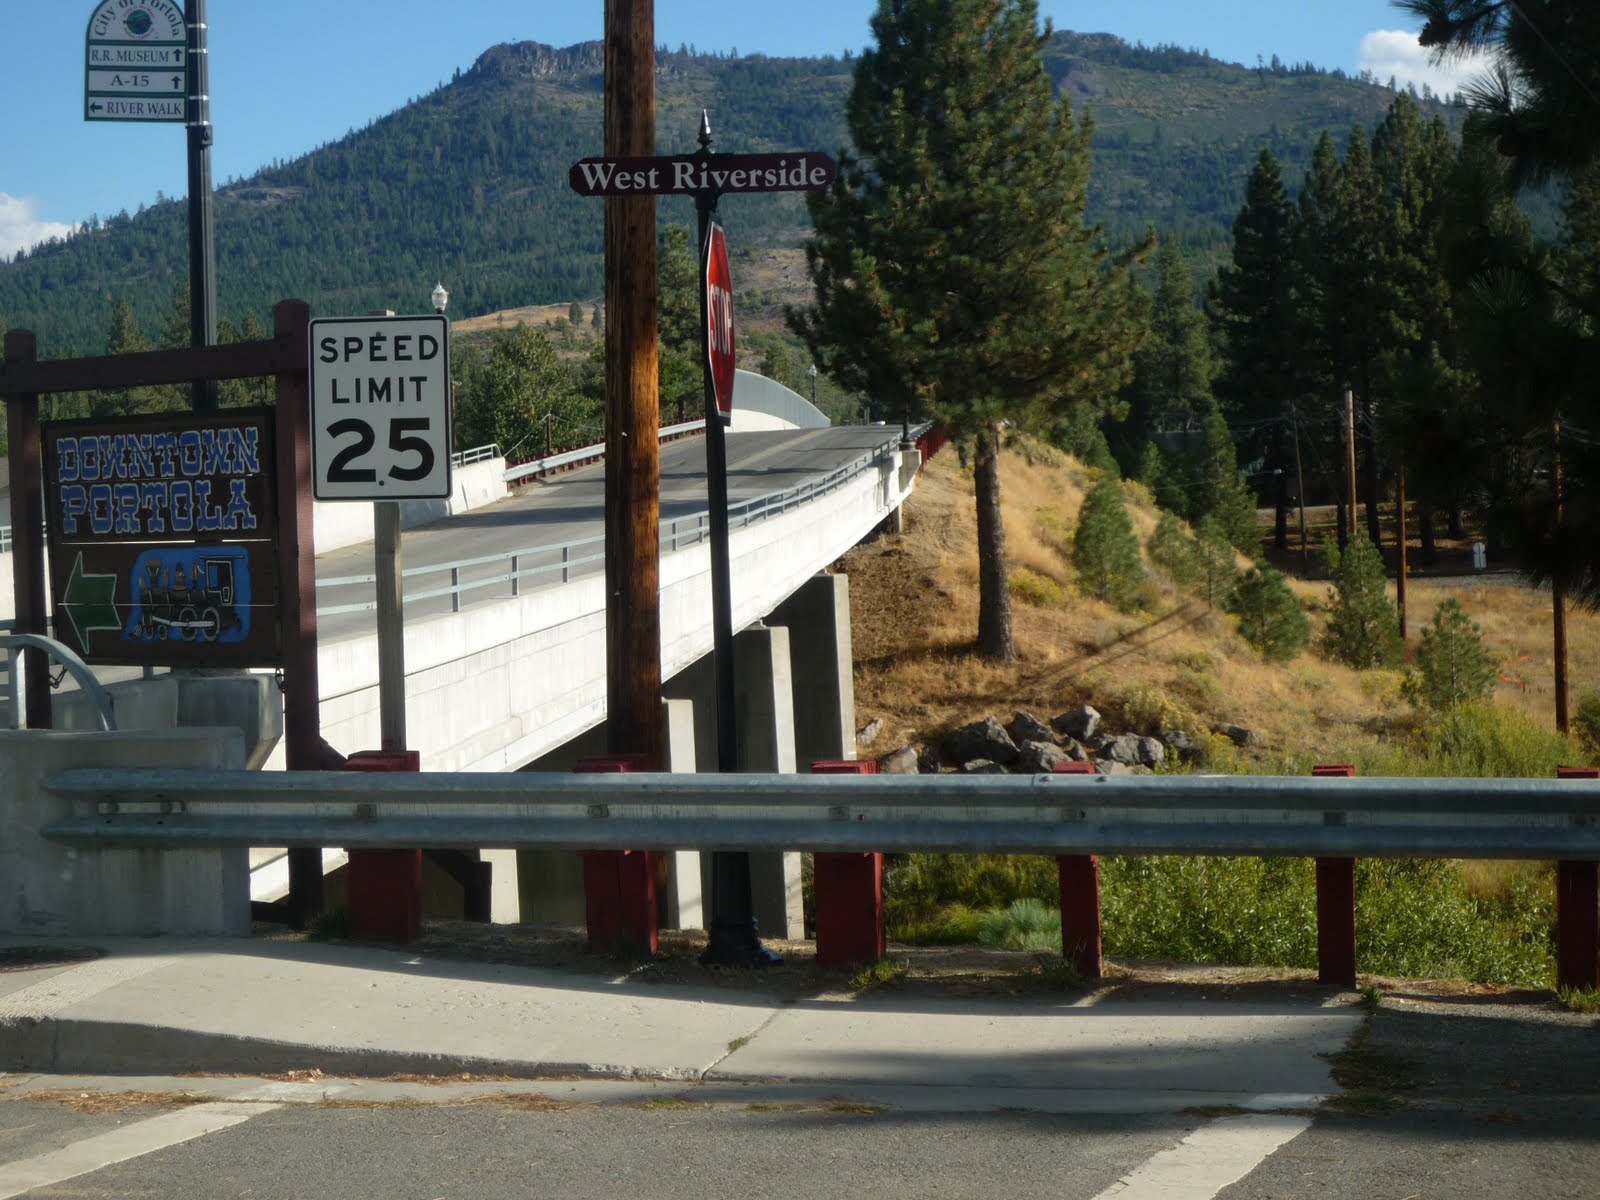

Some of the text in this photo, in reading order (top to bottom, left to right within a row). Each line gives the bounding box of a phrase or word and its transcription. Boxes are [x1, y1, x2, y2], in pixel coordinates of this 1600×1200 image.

[94, 6, 116, 36] City
[91, 49, 169, 62] R.R. MUSEUM
[110, 74, 150, 87] A-15
[107, 101, 182, 115] RIVER WALK
[579, 157, 827, 190] West Riverside
[709, 284, 732, 355] STOP
[320, 334, 439, 363] SPEED
[331, 376, 428, 404] LIMIT
[56, 427, 260, 482] DOWNTOWN
[326, 417, 435, 483] 25
[61, 479, 257, 534] PORTOLA
